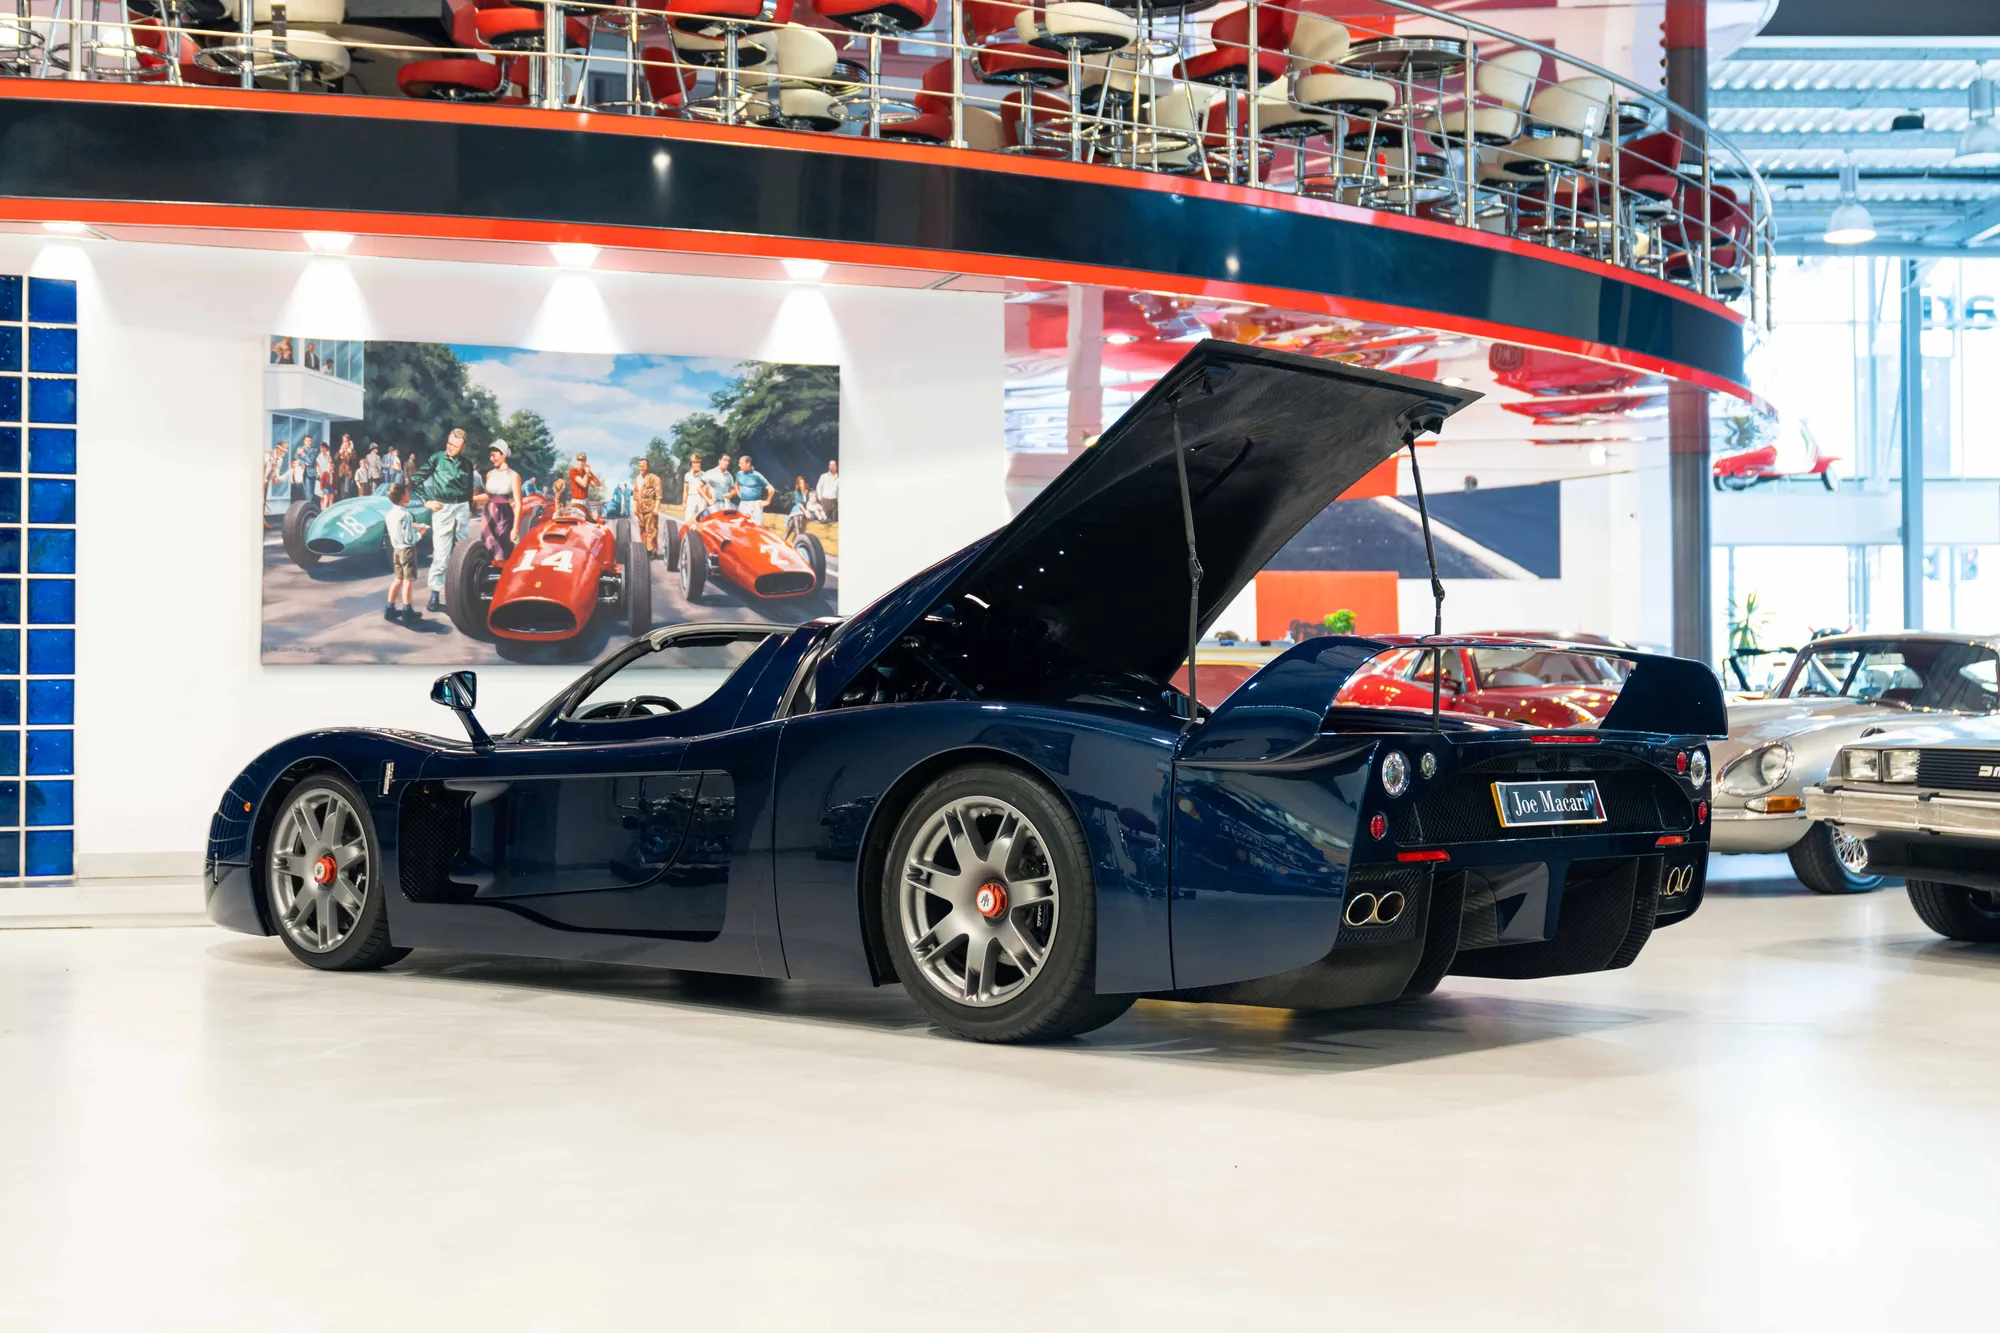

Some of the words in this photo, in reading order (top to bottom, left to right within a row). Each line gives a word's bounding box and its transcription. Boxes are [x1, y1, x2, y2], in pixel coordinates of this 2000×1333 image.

[336, 515, 367, 537] 18
[512, 549, 573, 574] 14
[760, 544, 790, 566] 2
[1512, 791, 1539, 817] Joe
[1538, 789, 1589, 813] Macari
